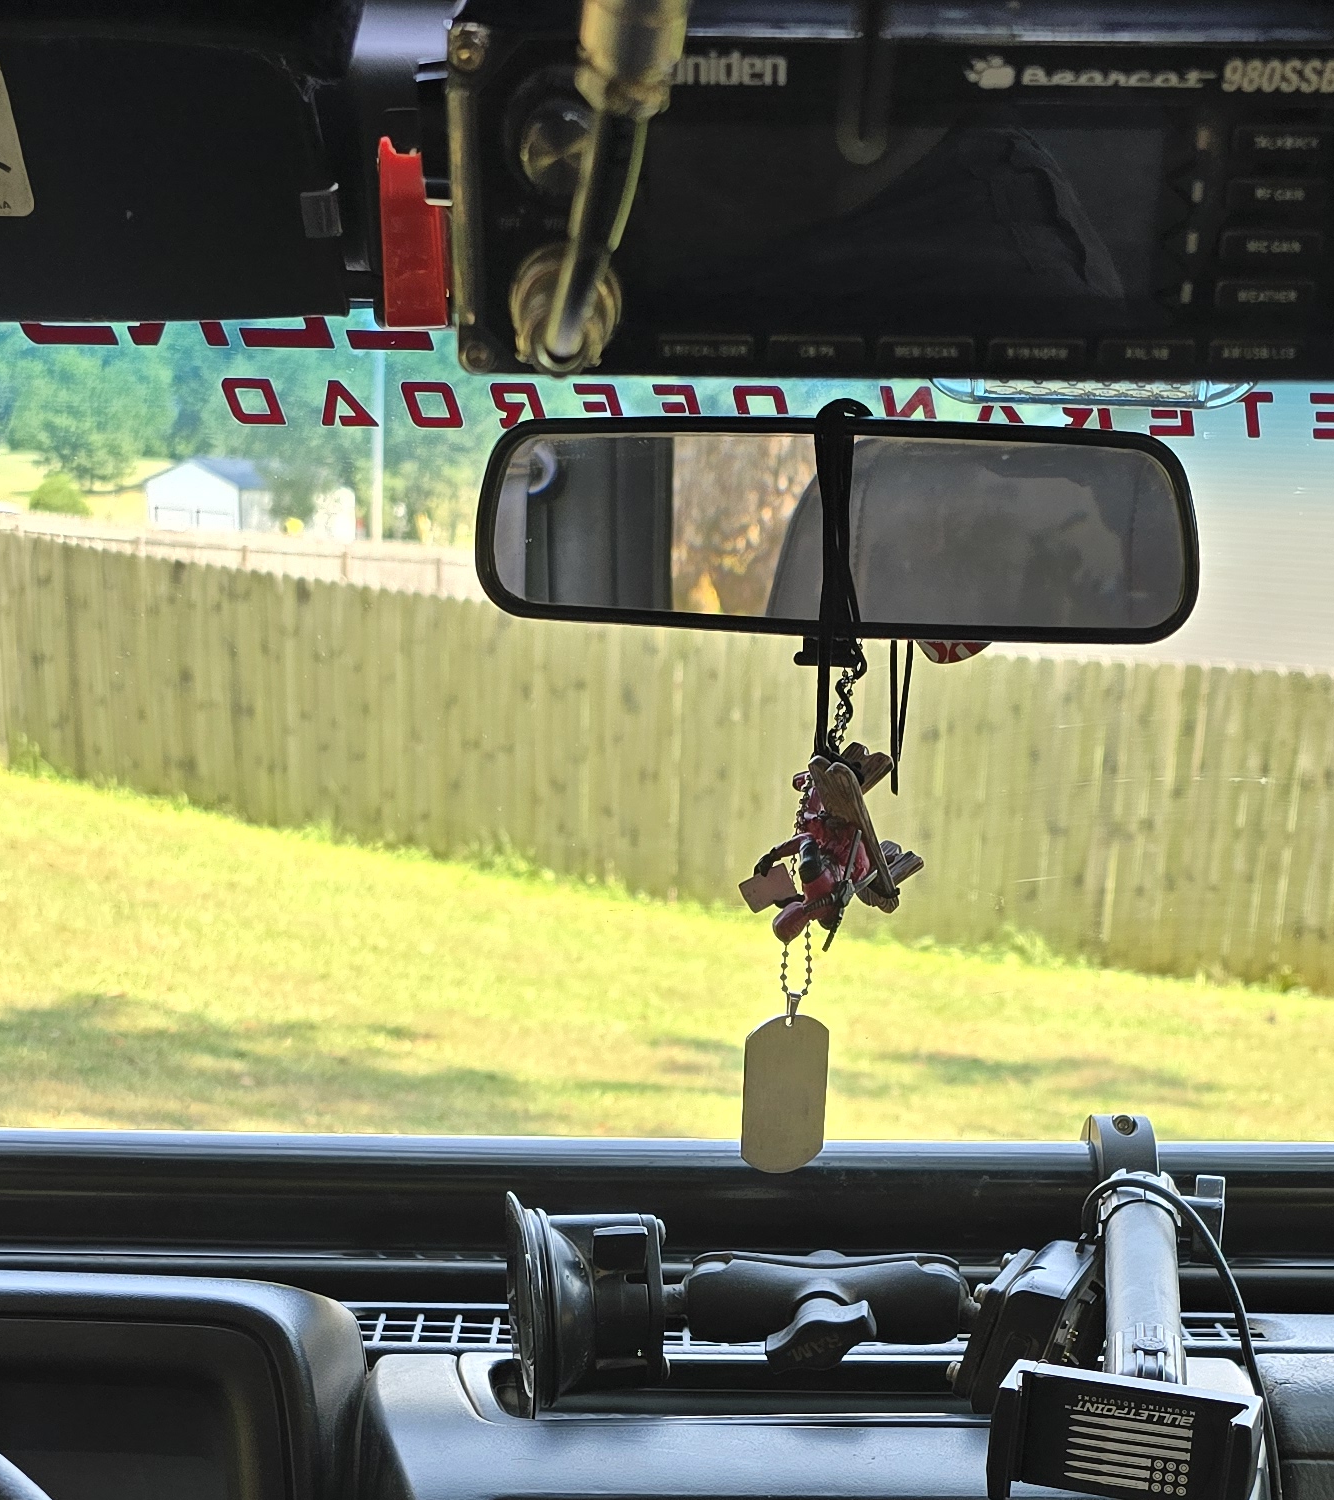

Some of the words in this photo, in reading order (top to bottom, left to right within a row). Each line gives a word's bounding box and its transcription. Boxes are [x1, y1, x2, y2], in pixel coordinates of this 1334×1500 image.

[1078, 1394, 1135, 1408] SOLUTIONS
[1073, 1401, 1194, 1427] BULLETPOINT
[1142, 1403, 1196, 1417] MOUNTING
